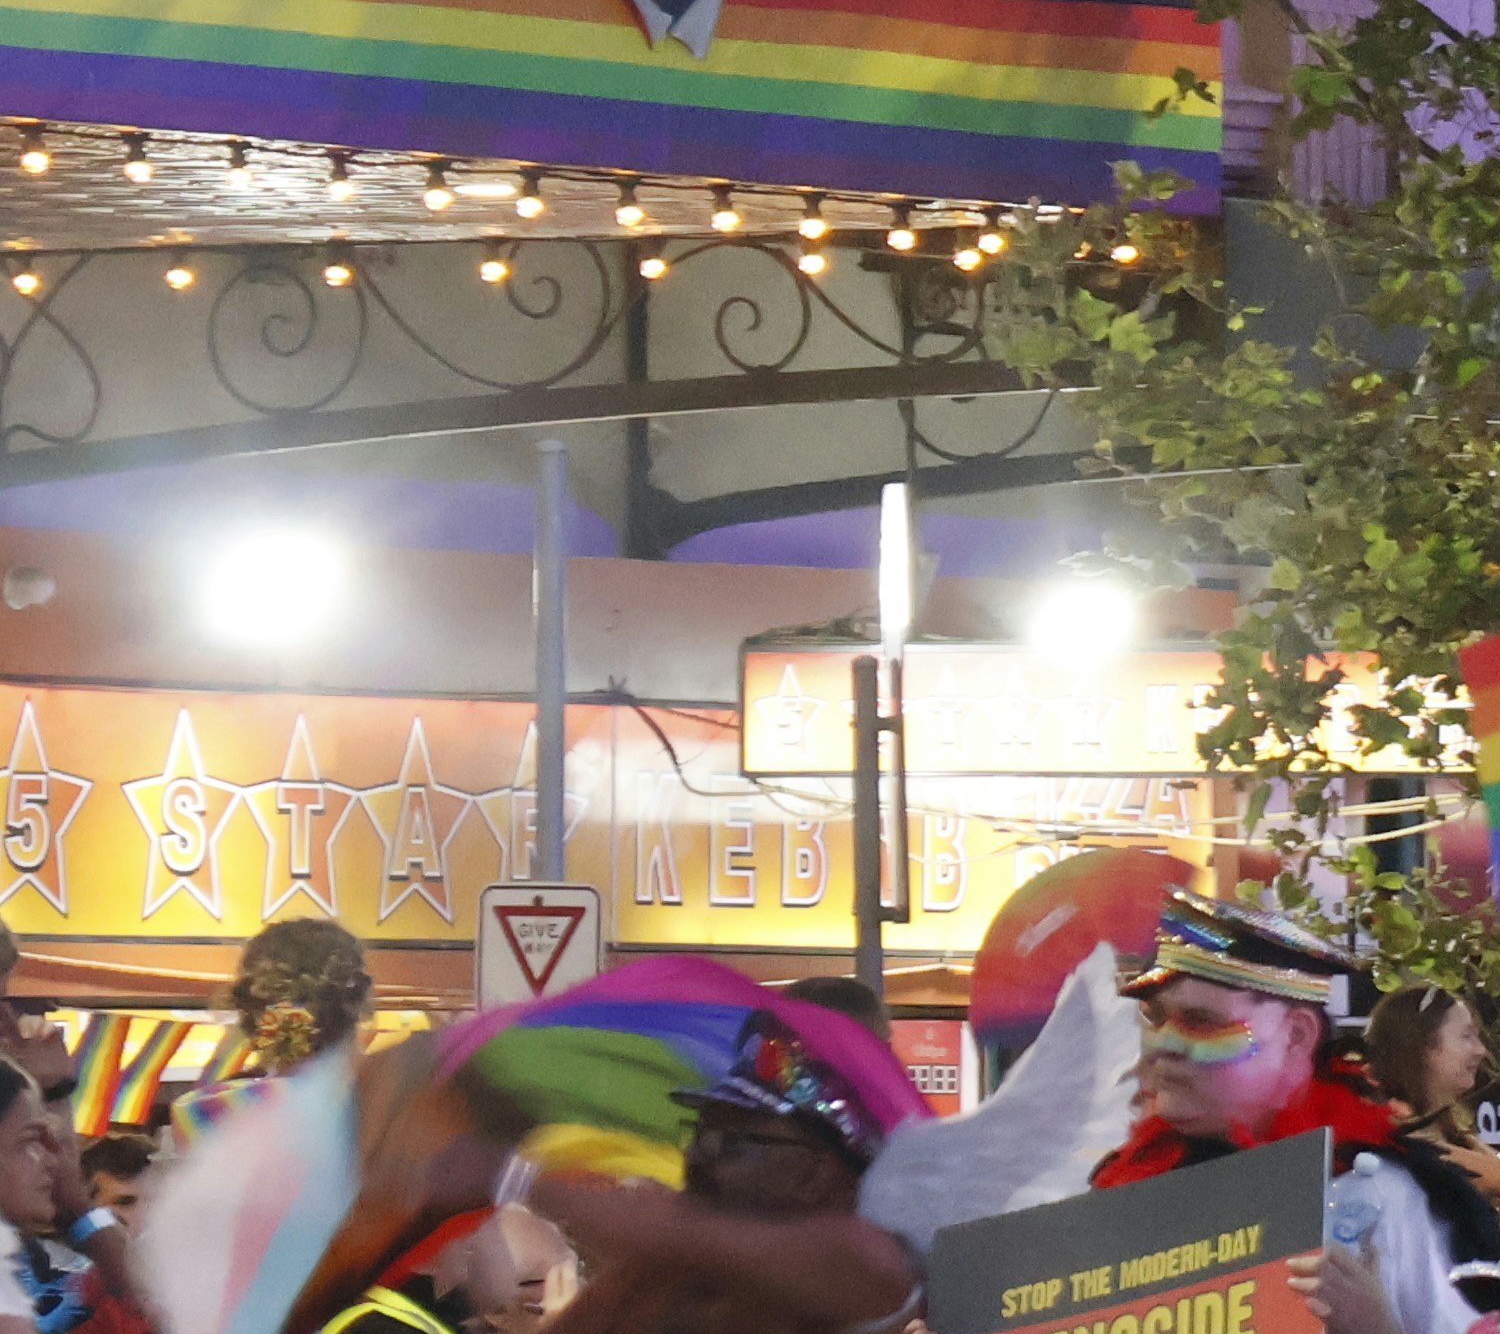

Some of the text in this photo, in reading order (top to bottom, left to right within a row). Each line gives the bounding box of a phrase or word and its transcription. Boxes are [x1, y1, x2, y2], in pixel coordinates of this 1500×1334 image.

[3, 779, 50, 868] 5
[1001, 1224, 1263, 1318] STOP THE MODERN-DAY
